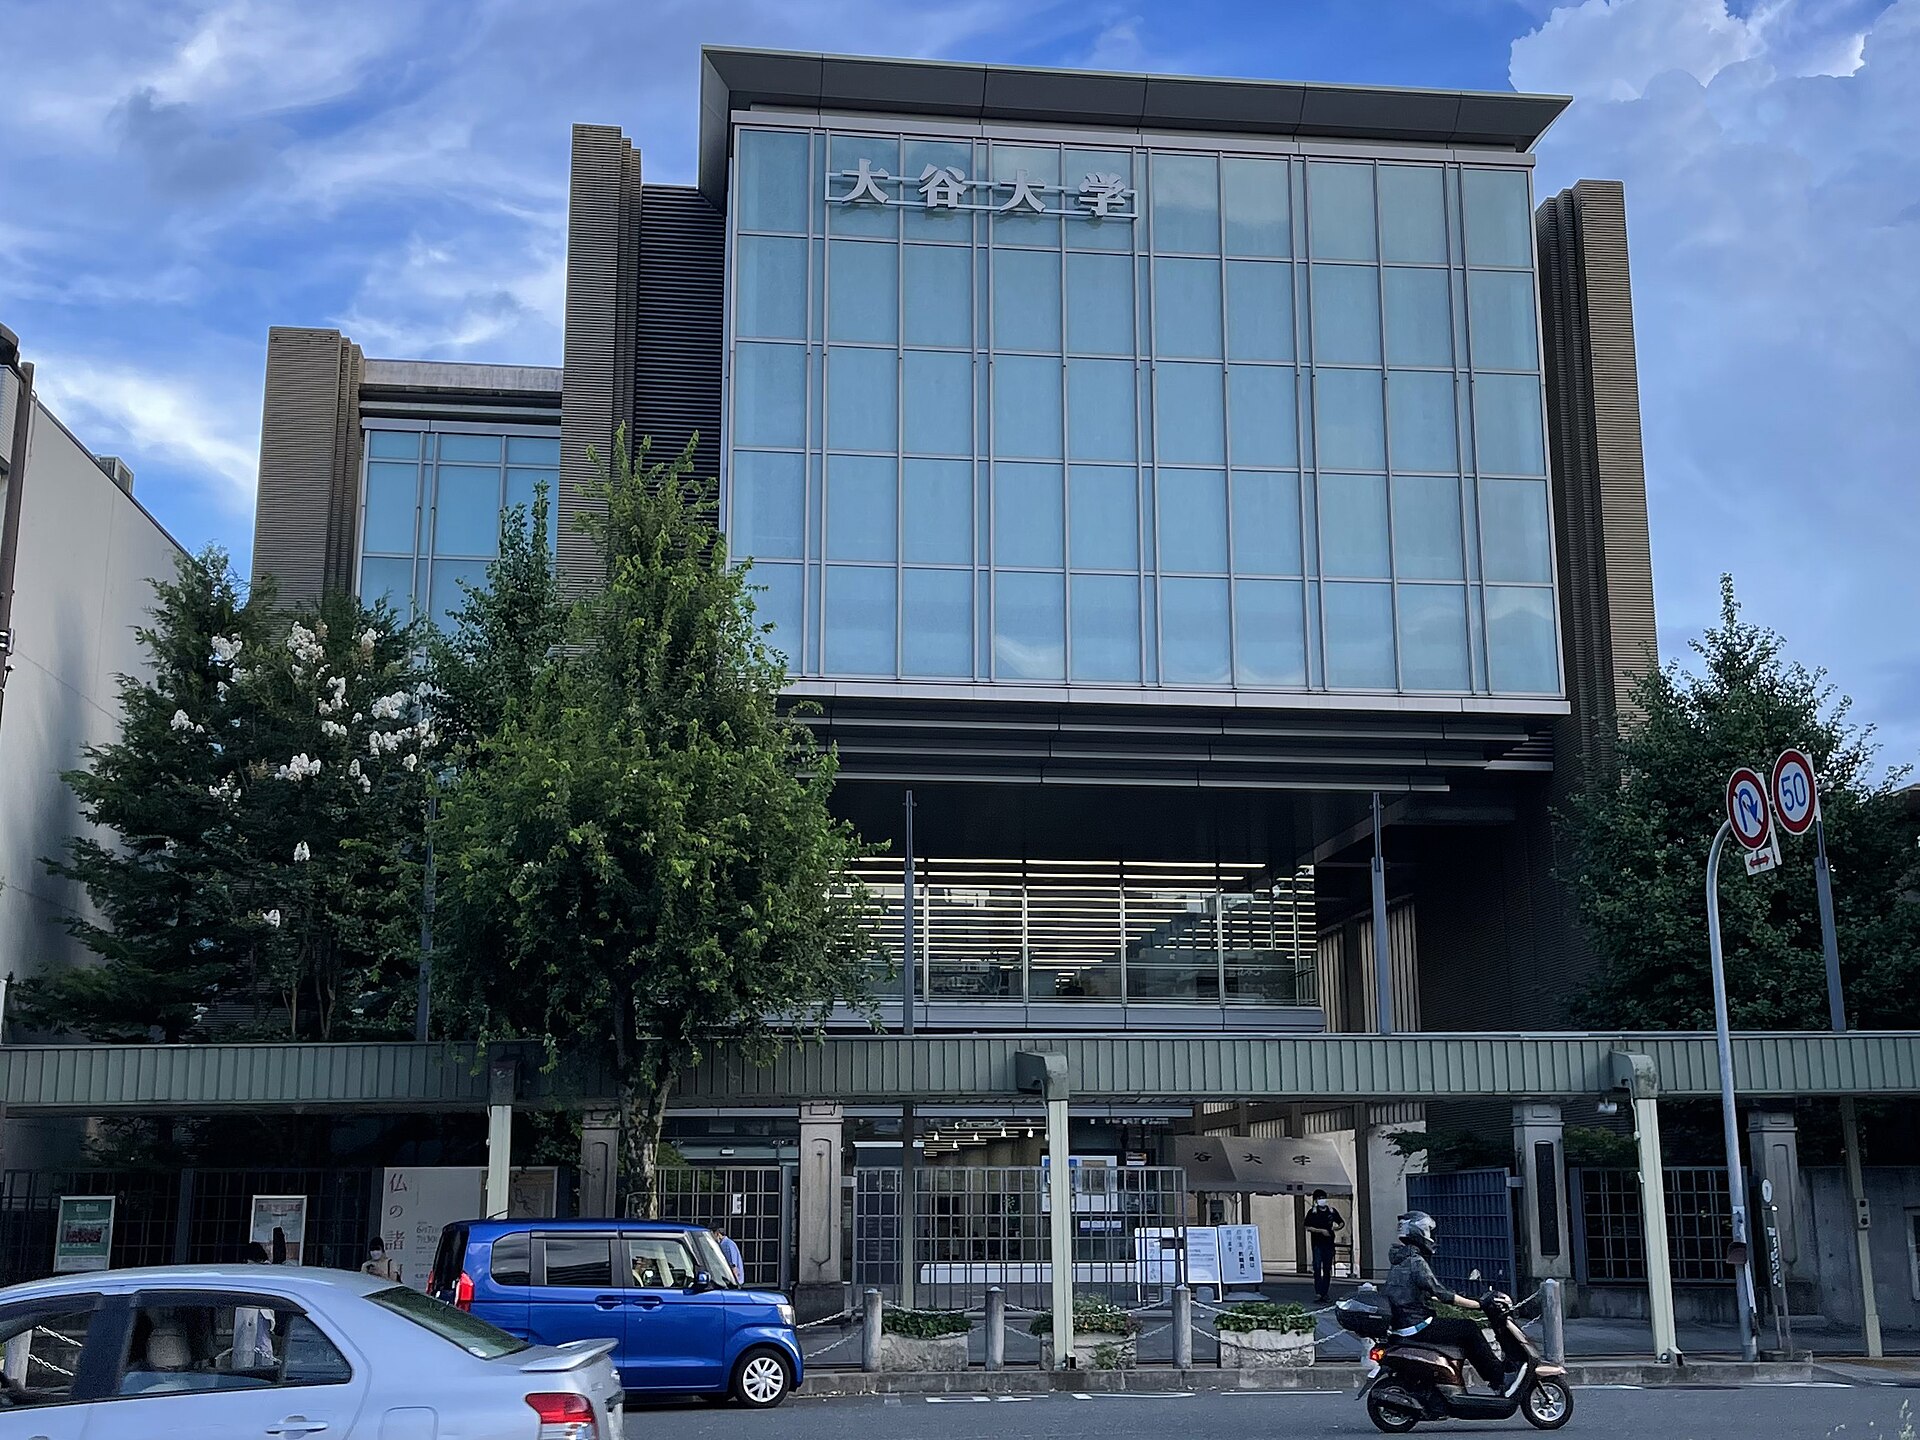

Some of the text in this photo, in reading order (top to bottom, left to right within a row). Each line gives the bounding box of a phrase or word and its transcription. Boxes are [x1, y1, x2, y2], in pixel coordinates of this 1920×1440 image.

[841, 158, 1126, 216] 大谷大学
[1781, 772, 1806, 811] 50
